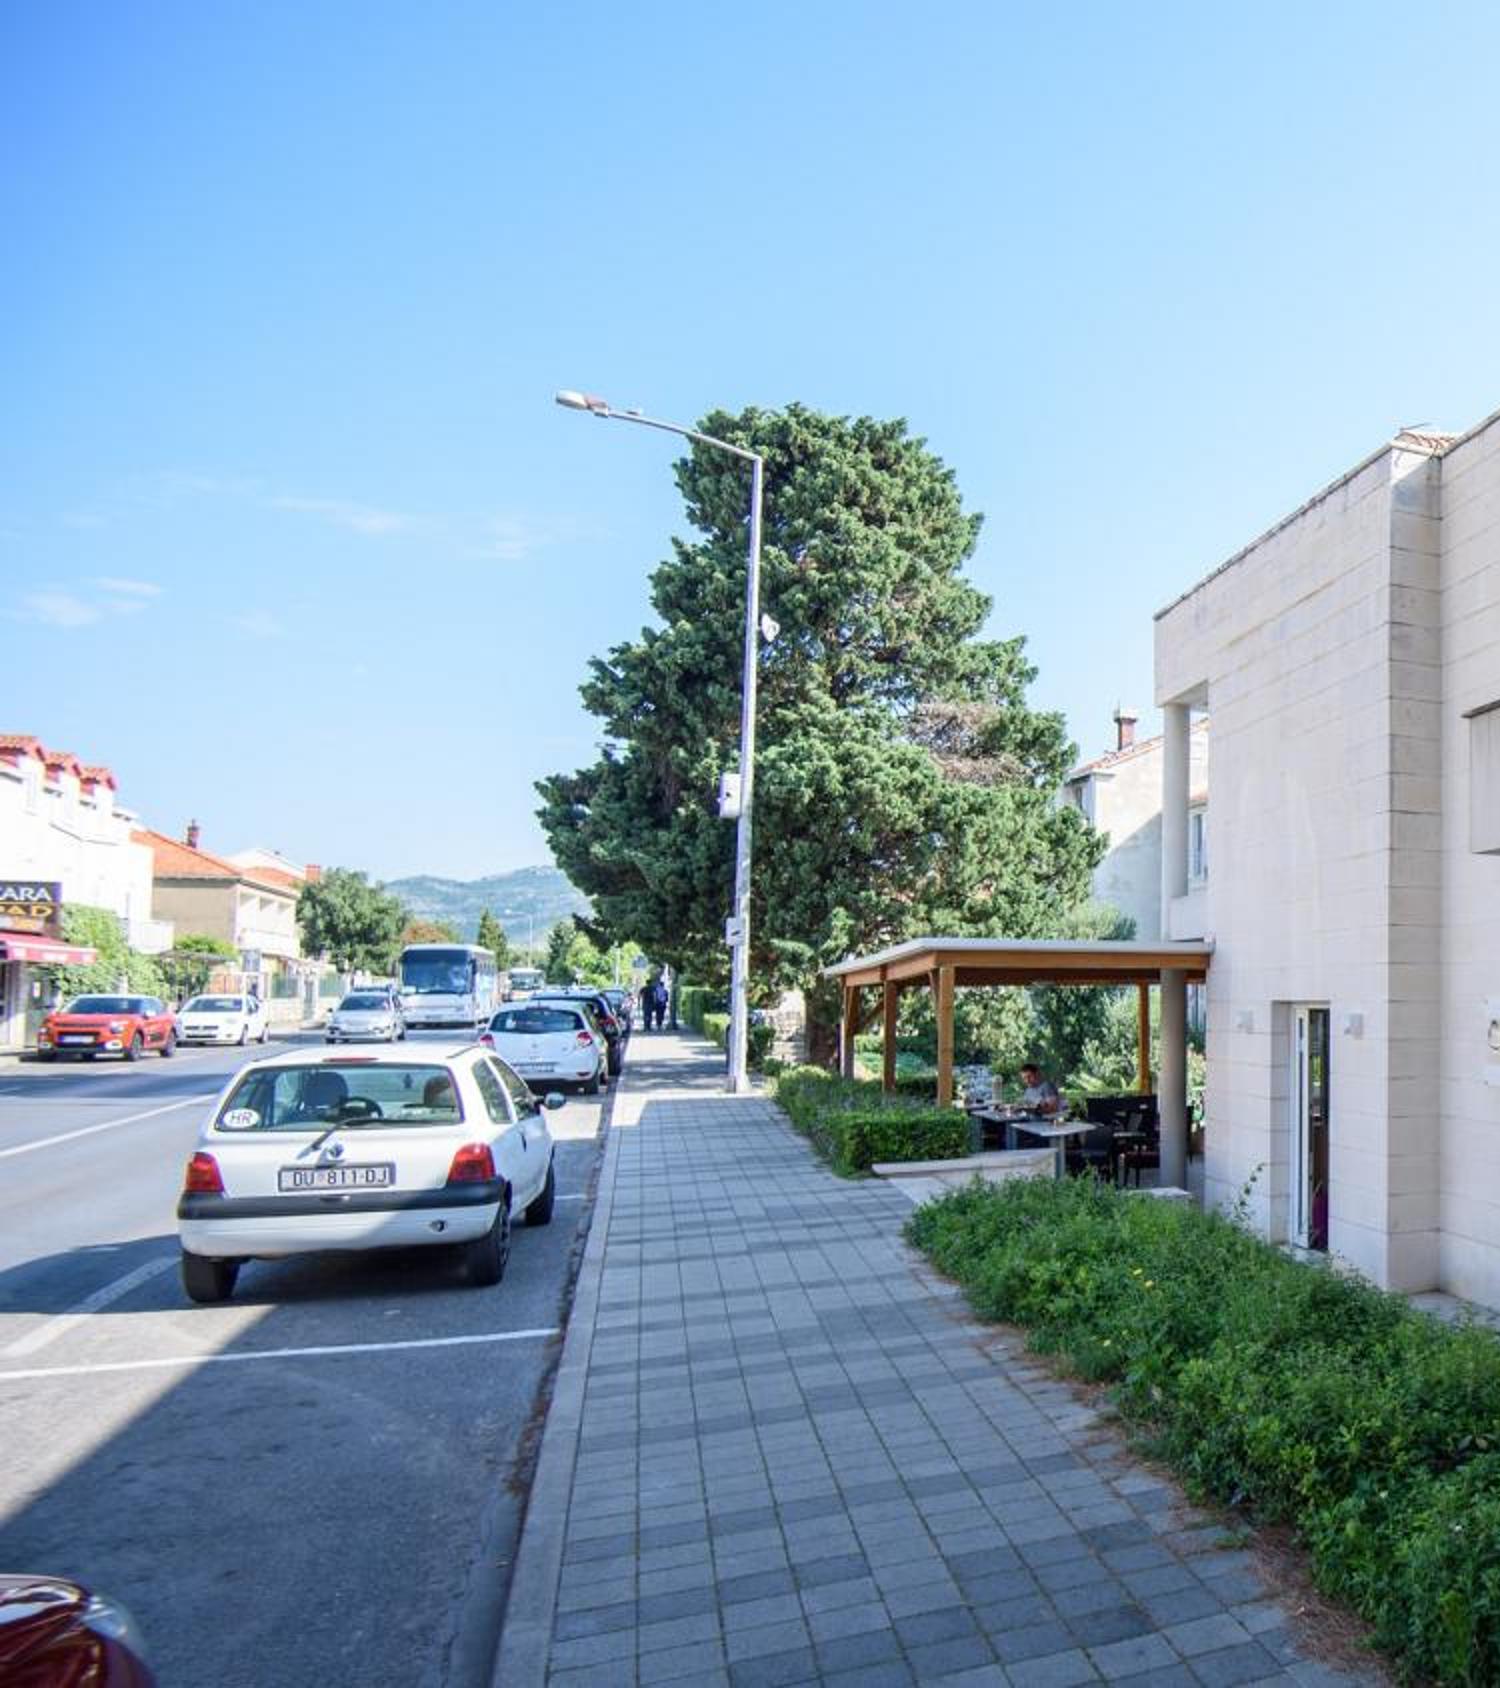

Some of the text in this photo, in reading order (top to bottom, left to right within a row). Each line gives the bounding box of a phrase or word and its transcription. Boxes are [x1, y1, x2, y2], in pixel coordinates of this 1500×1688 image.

[0, 886, 52, 901] ARA
[231, 1111, 253, 1124] HR
[293, 1171, 315, 1186] DU
